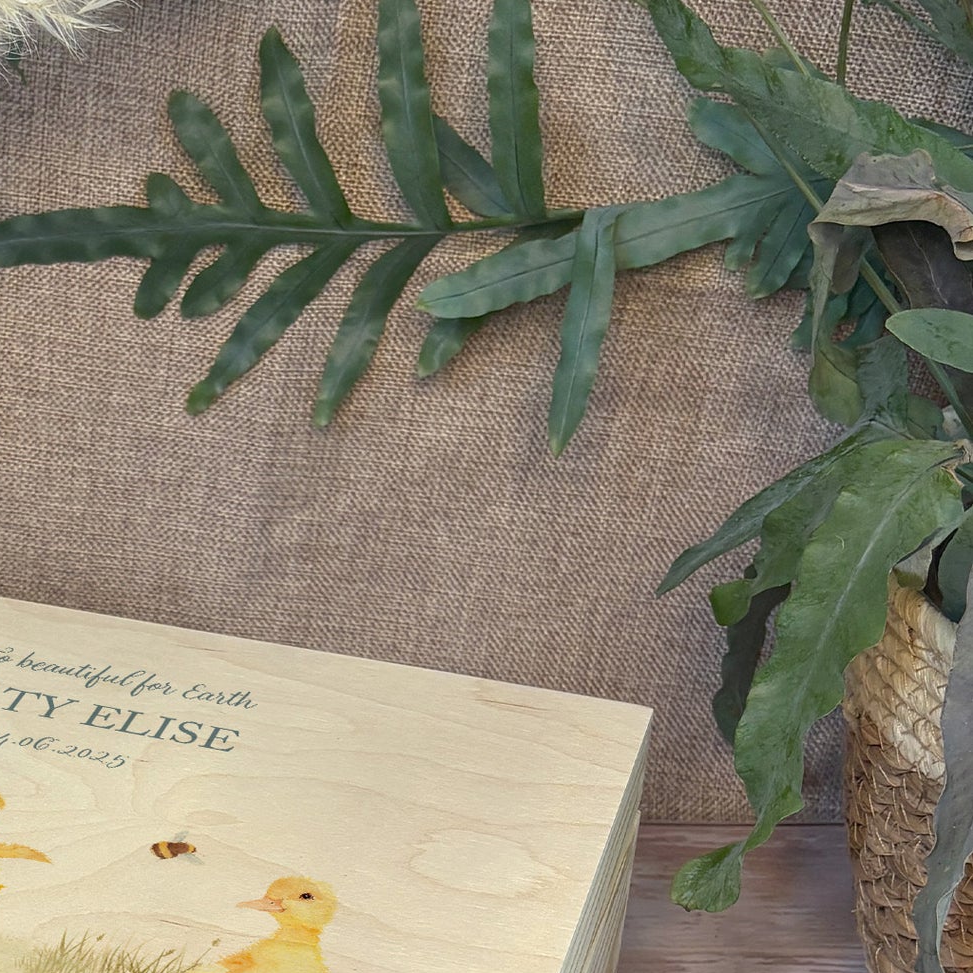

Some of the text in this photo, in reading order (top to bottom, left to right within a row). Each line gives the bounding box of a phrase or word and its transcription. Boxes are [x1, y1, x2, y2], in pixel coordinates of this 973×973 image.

[15, 651, 146, 689] beautiful
[130, 673, 178, 698] for
[182, 683, 258, 711] Earth
[80, 703, 240, 753] ELISE
